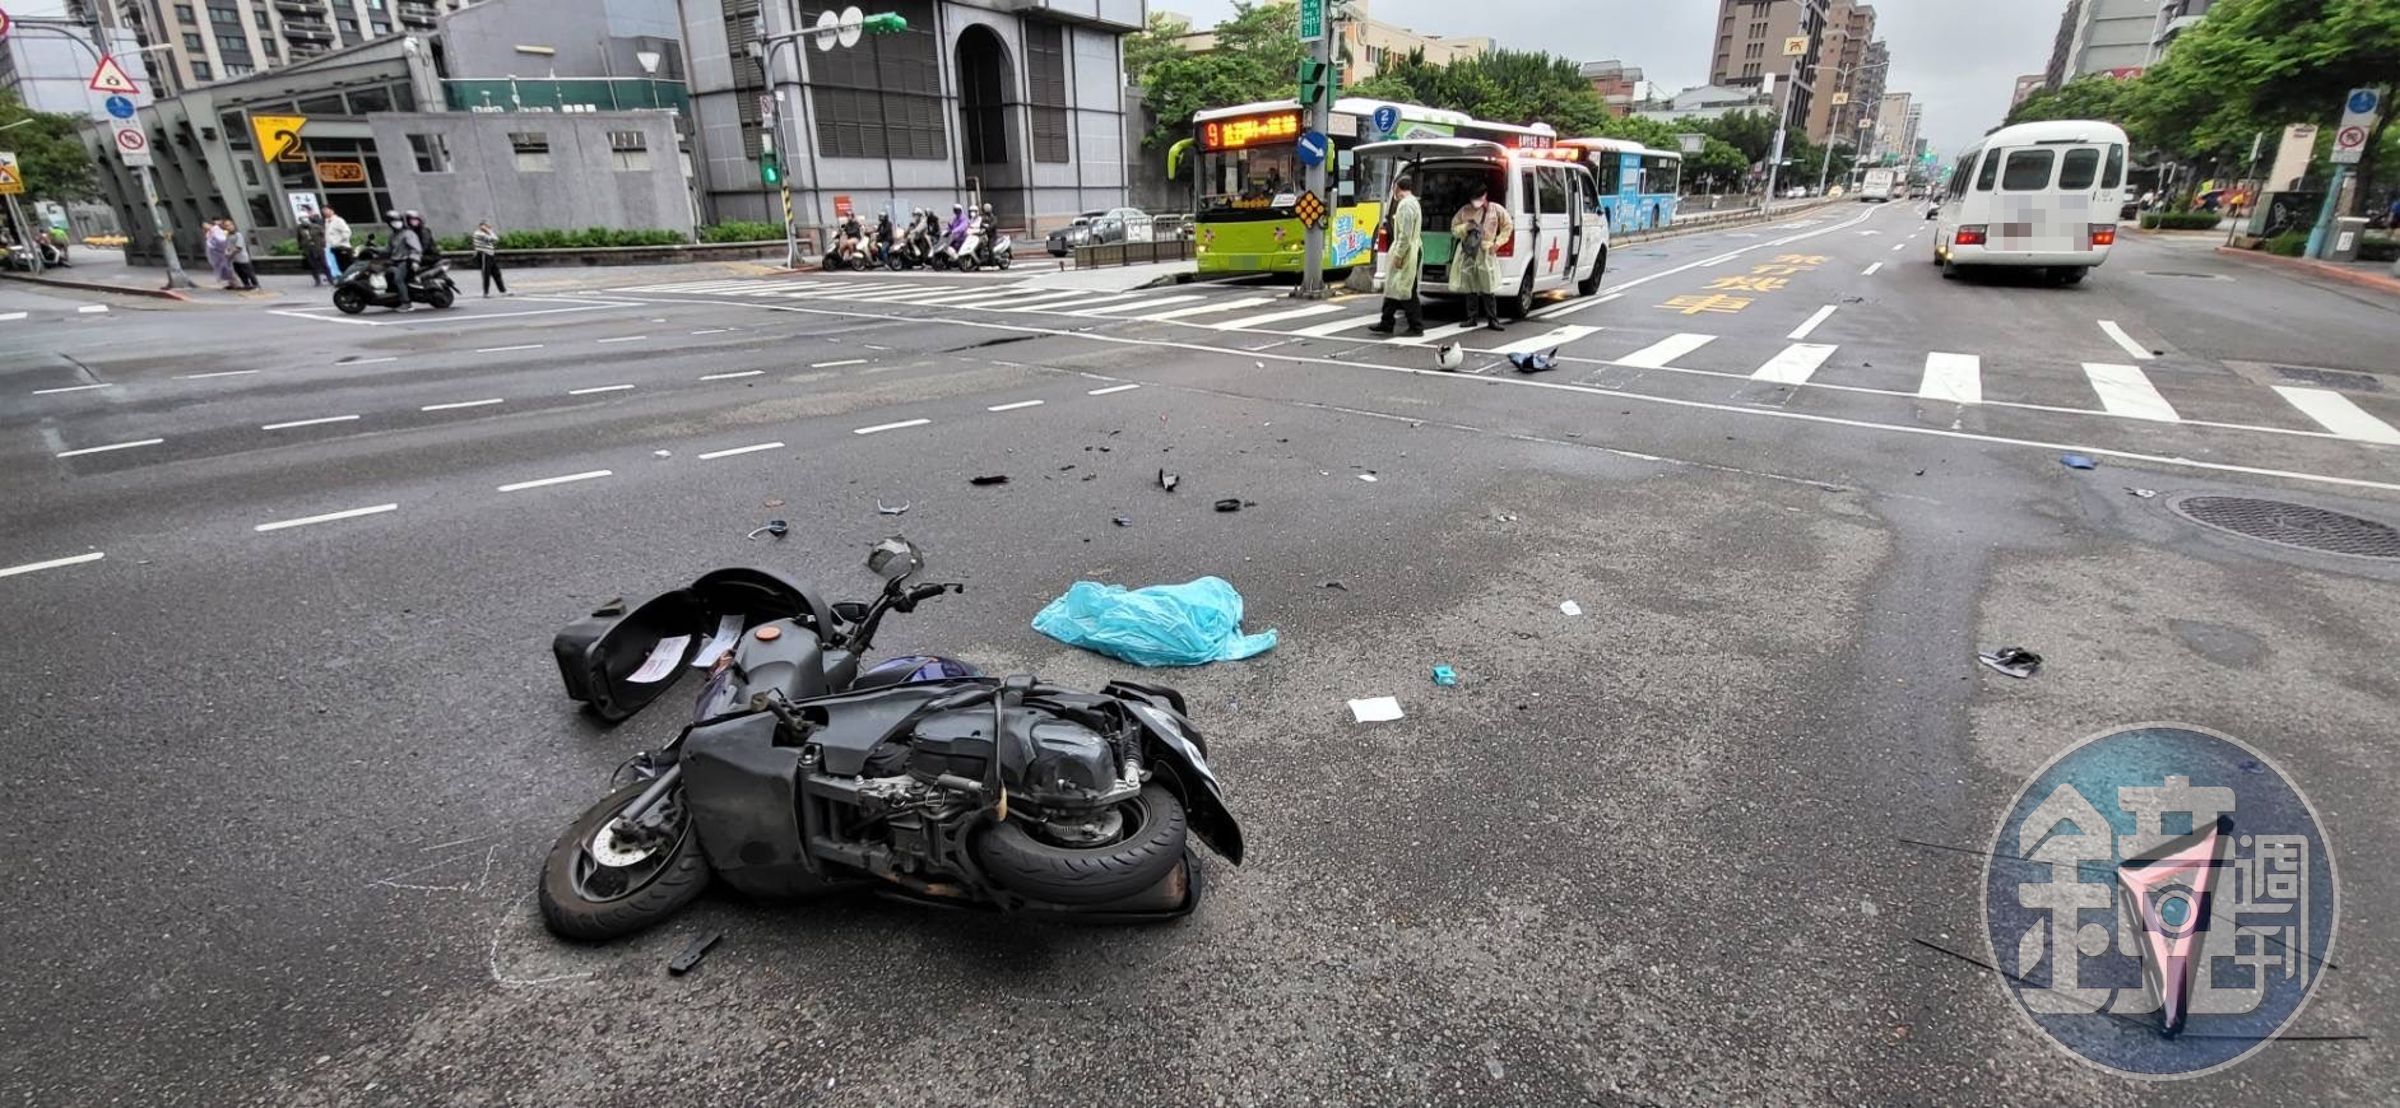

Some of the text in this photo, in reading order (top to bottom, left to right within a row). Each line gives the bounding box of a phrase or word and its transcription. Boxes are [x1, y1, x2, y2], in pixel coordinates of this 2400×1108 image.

[1380, 109, 1389, 121] 2
[274, 129, 307, 162] 2
[1207, 123, 1218, 146] 9
